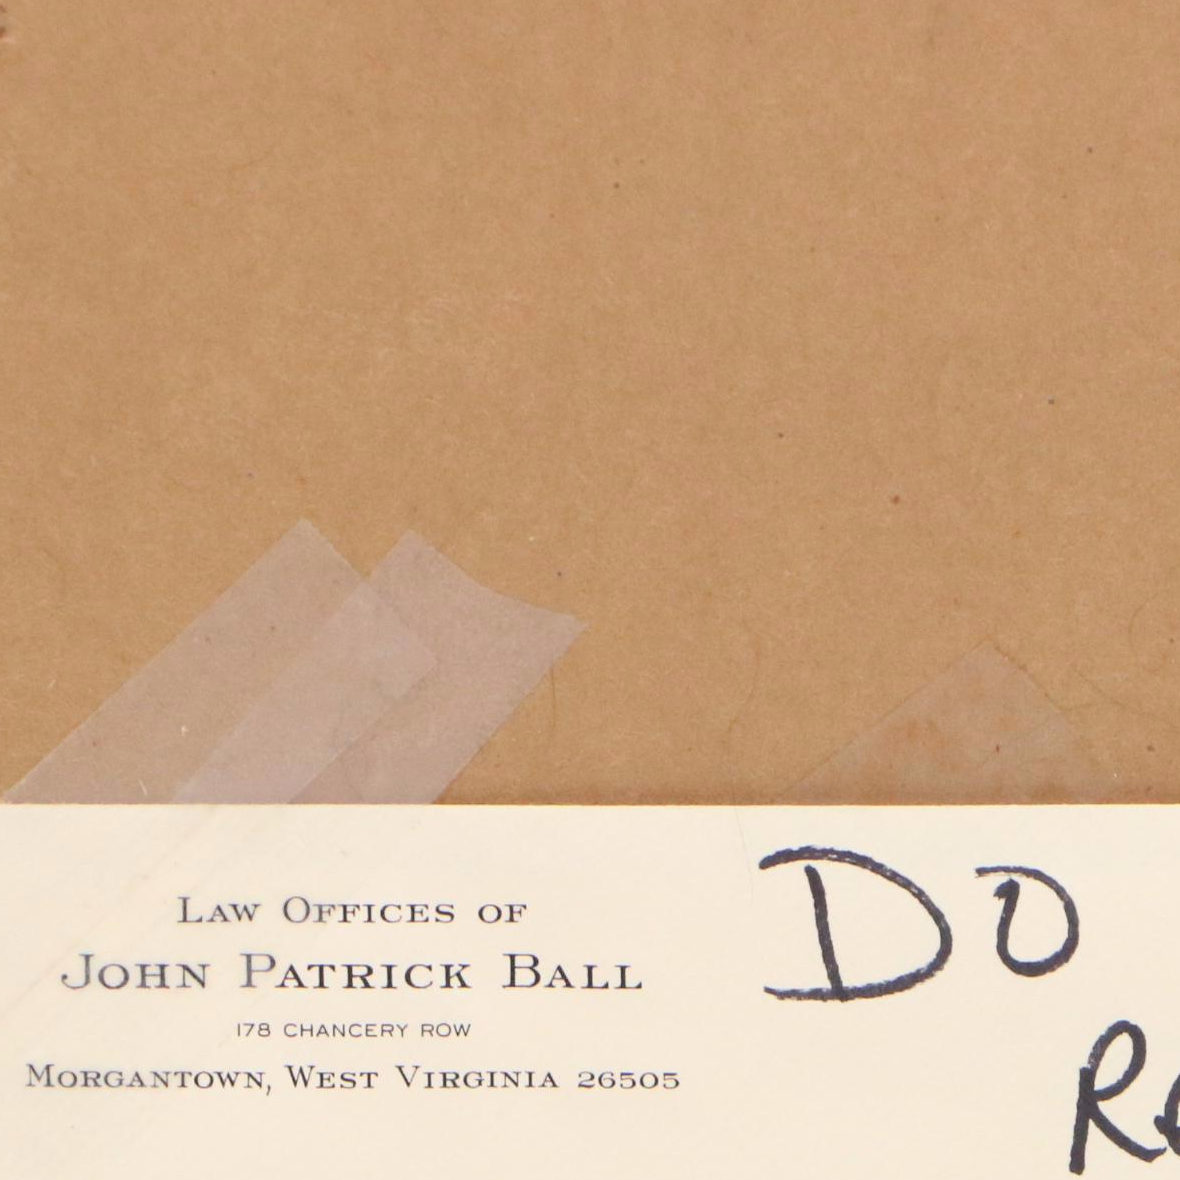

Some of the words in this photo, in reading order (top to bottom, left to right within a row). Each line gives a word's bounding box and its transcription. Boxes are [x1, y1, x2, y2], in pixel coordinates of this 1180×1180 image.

[478, 903, 527, 924] OF
[758, 845, 1080, 1003] Do
[236, 1022, 271, 1038] 178
[283, 1022, 408, 1038] CHANCERY
[421, 1022, 471, 1038] ROW
[577, 1072, 681, 1090] 26505
